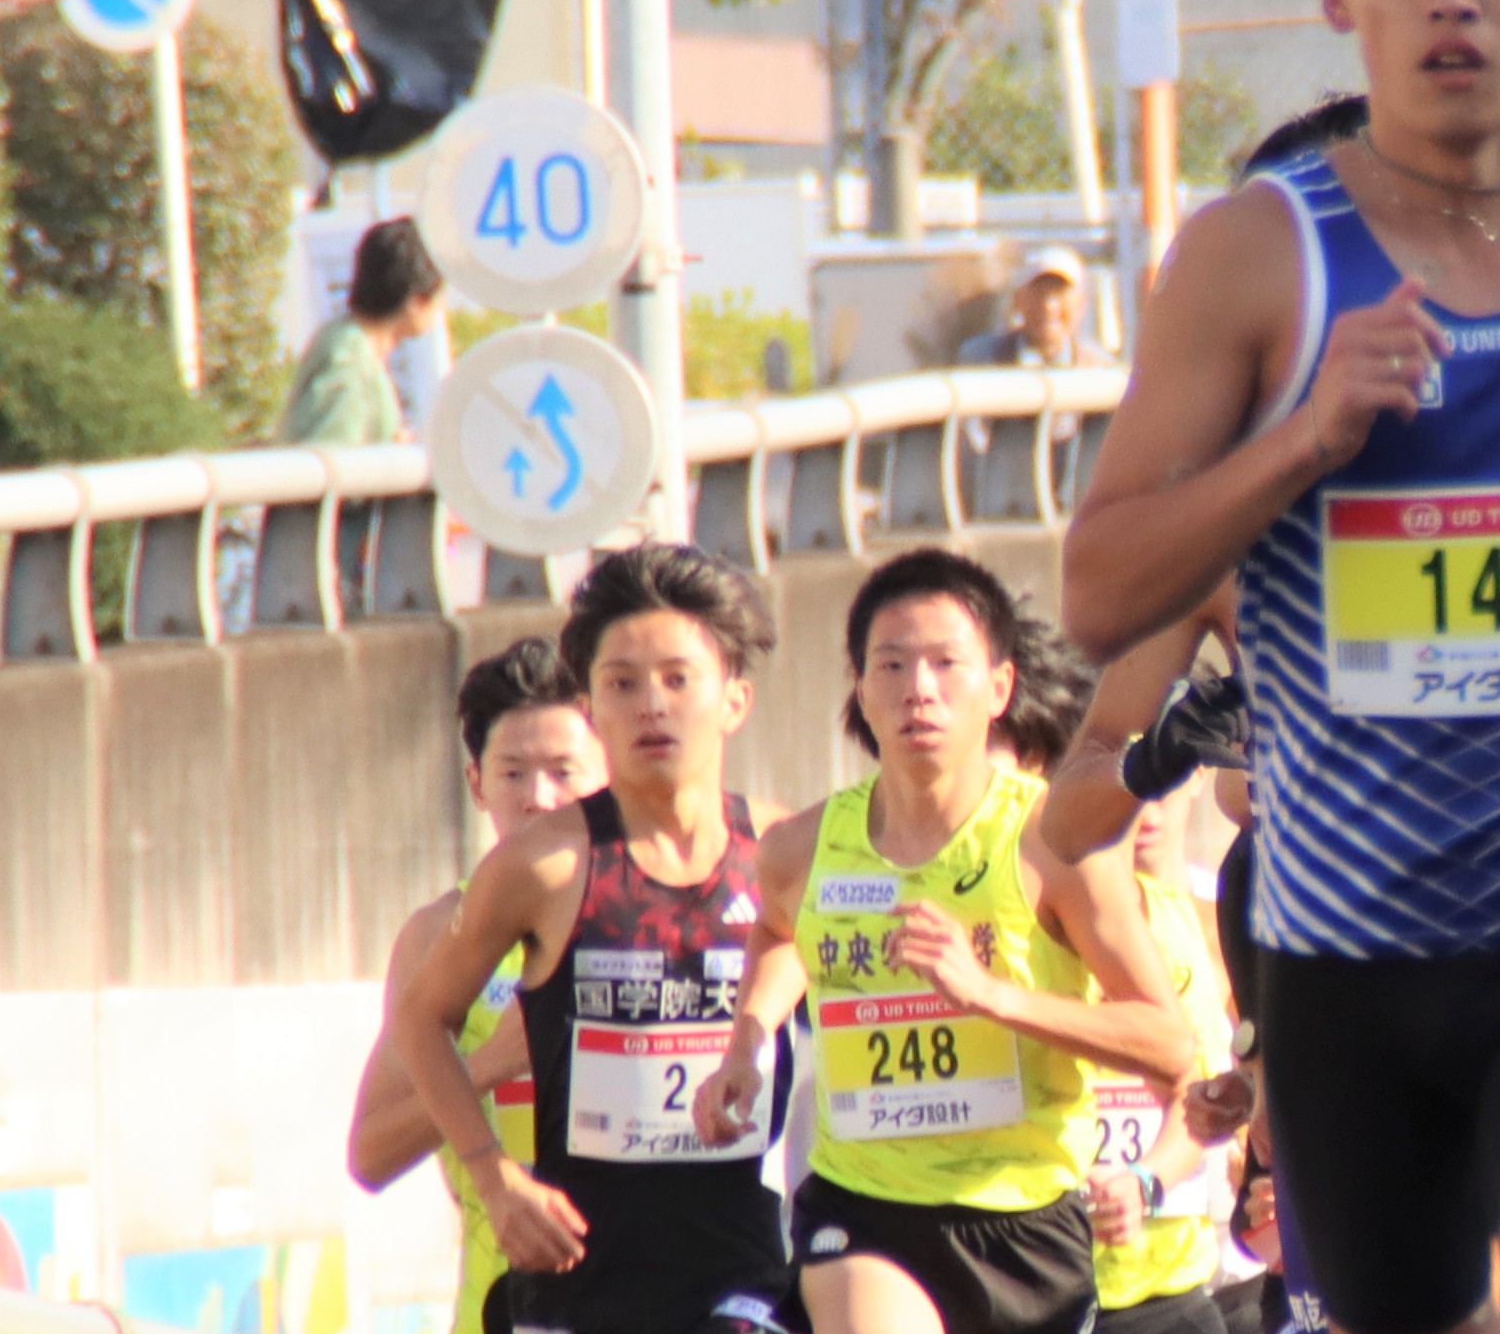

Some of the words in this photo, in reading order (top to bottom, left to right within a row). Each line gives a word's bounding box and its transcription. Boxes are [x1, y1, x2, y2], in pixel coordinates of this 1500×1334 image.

[476, 154, 590, 248] 40
[1452, 510, 1482, 526] UD
[884, 1005, 904, 1017] UD
[867, 1025, 959, 1085] 248
[663, 1062, 687, 1111] 2
[870, 1099, 971, 1130] アイダ設計
